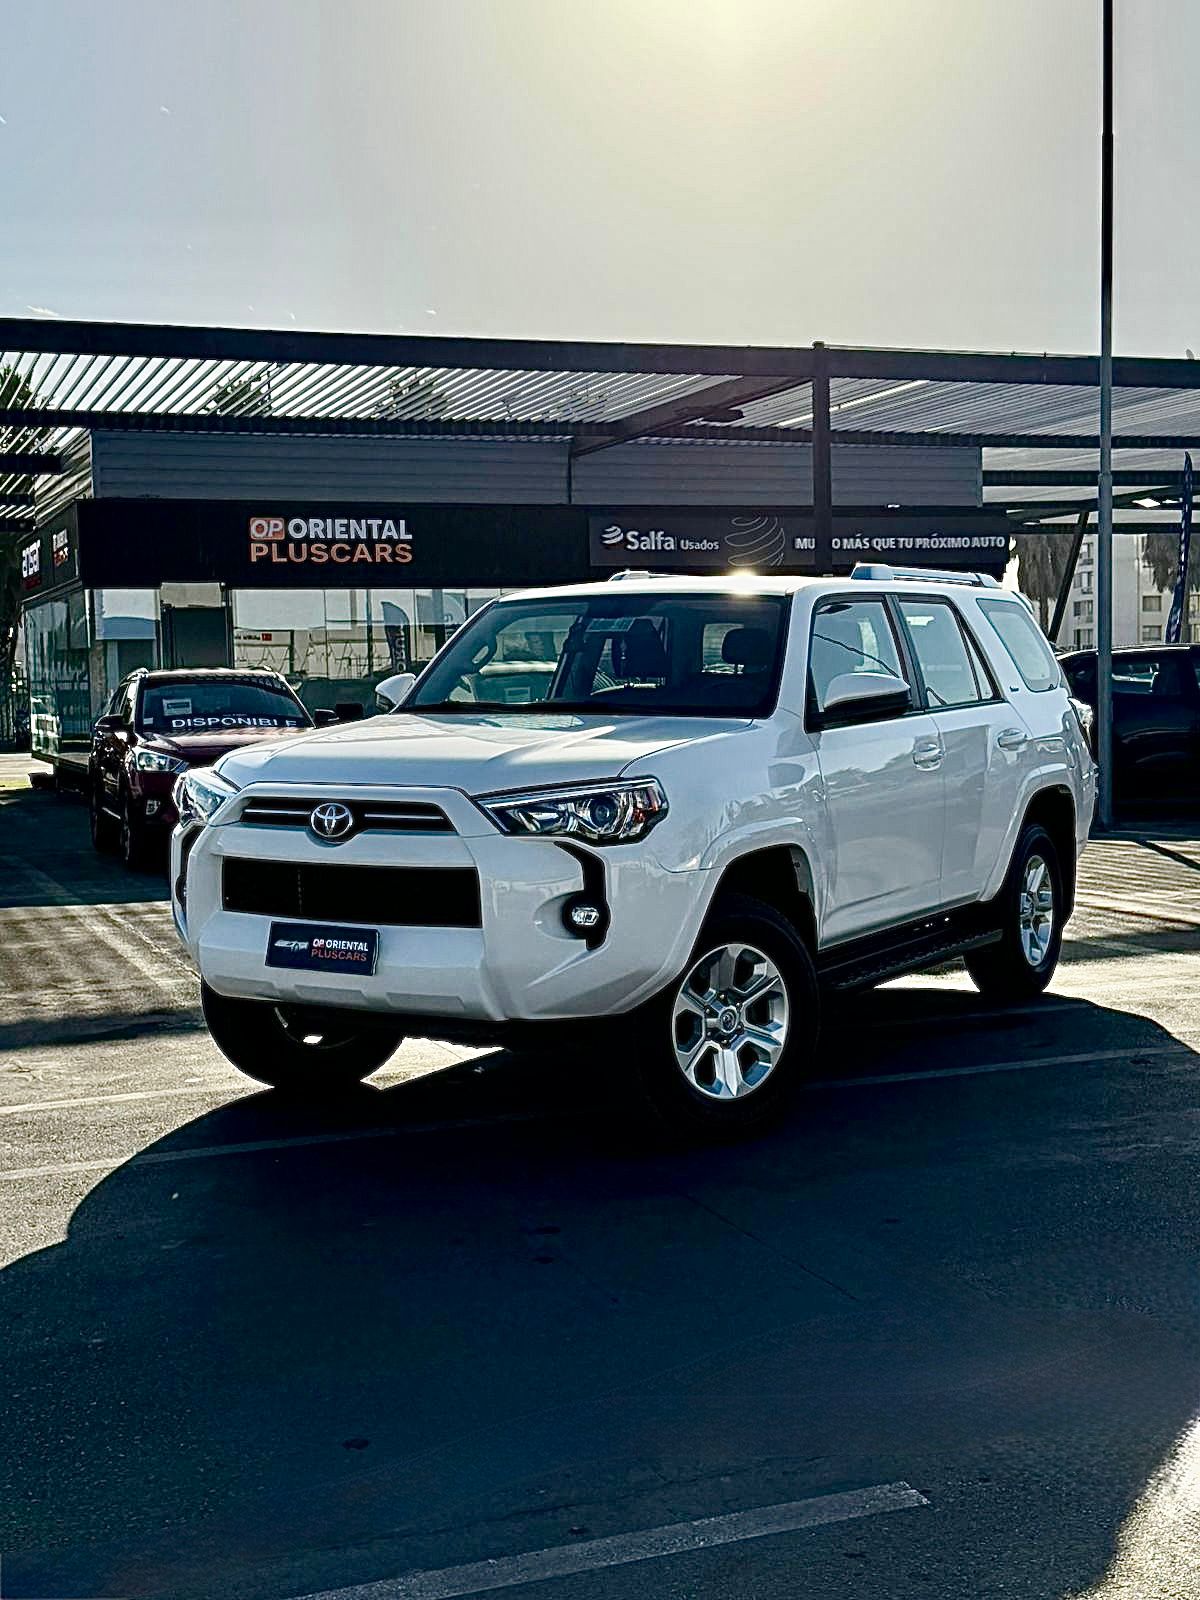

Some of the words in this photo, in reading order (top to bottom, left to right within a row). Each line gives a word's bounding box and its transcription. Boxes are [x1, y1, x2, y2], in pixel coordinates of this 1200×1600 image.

[251, 518, 284, 539] OP
[287, 518, 413, 540] ORIENTAL
[626, 530, 675, 551] Salfa
[680, 539, 719, 551] Usados
[795, 538, 841, 550] MUO
[843, 532, 870, 550] MÁS
[871, 537, 896, 552] QUE
[897, 537, 913, 550] TU
[915, 532, 973, 549] PRÓXIMO
[972, 536, 1005, 548] AUTO
[250, 542, 413, 563] PLUSCARS
[311, 948, 367, 962] PLUSCARS
[326, 939, 369, 952] ORIENTAL
